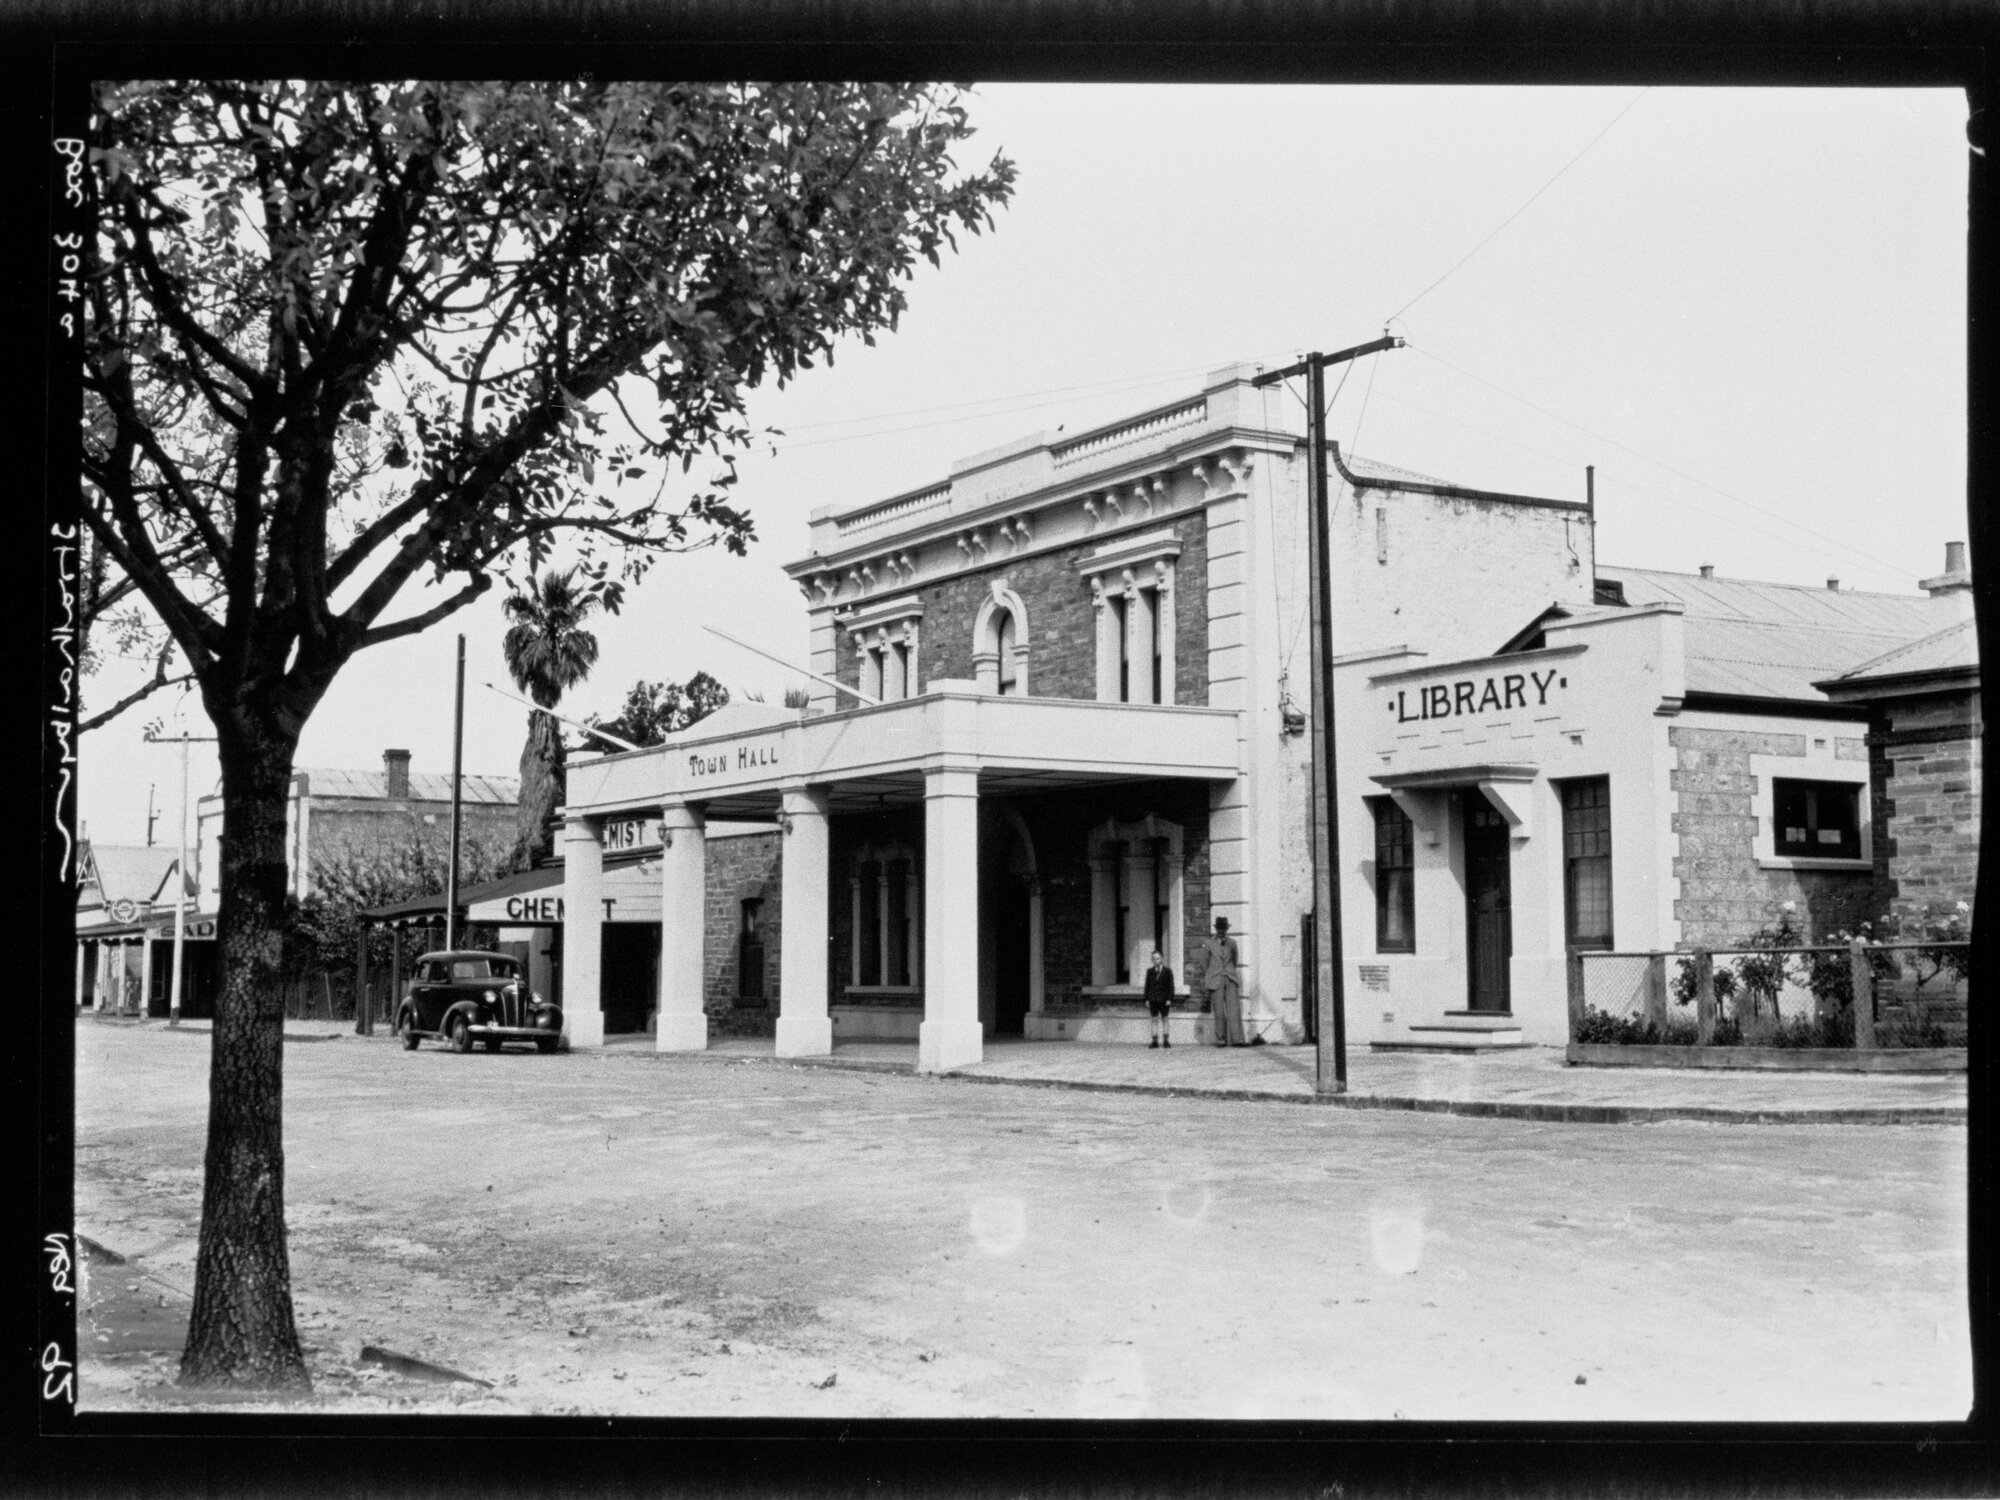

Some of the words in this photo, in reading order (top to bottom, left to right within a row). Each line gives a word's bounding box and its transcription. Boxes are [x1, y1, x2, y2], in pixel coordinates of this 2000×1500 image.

[1398, 669, 1557, 723] LIBRARY
[689, 754, 727, 776] TOWN
[738, 747, 778, 769] HALL
[602, 820, 646, 849] EMIST
[506, 897, 617, 920] CHET
